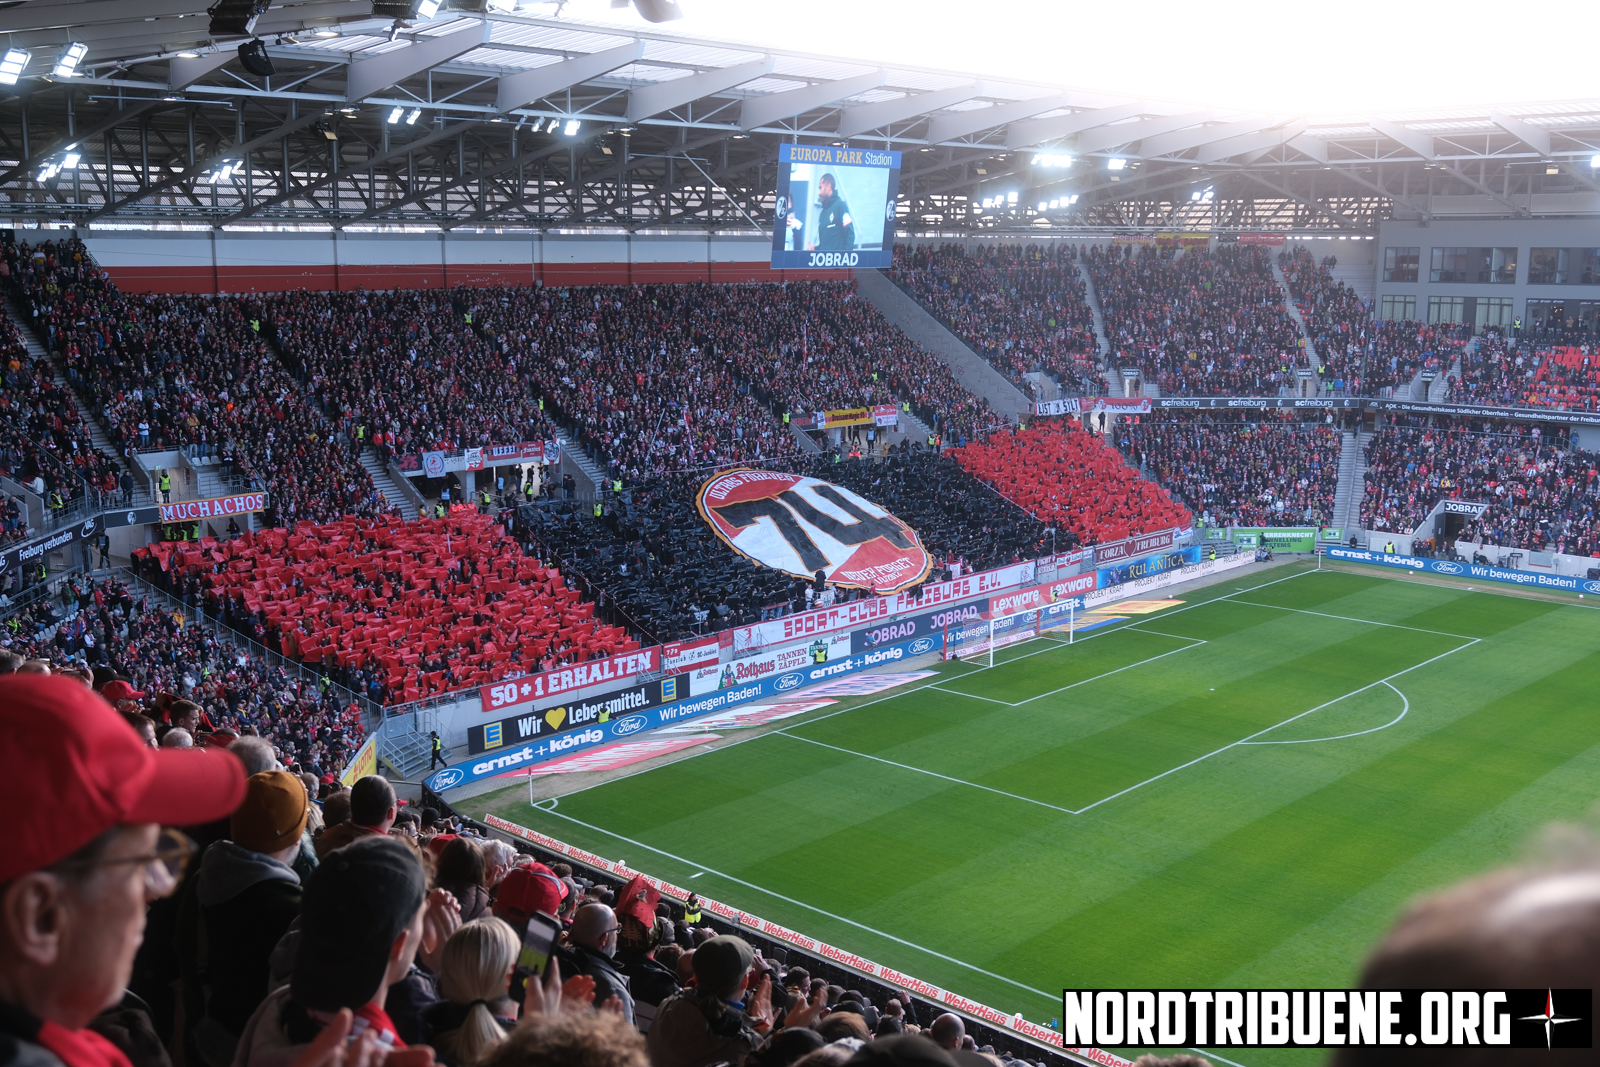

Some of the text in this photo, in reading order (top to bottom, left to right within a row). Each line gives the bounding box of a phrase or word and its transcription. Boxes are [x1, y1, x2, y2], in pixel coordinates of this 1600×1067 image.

[790, 147, 892, 165] EUROPA PARK Stadion
[808, 252, 859, 266] JOBRAD
[1161, 399, 1199, 407] scfreiburg
[1228, 399, 1266, 407] scfreiburg
[1295, 399, 1333, 407] scfreiburg
[1411, 405, 1456, 413] Gesundheitskasse
[1457, 407, 1481, 415] Südlicher
[1514, 411, 1569, 421] Gesundheitspartner
[708, 471, 796, 500] ULTRAS FOREVER
[161, 494, 264, 522] MUCHACHOS
[709, 484, 918, 574] 74
[19, 530, 73, 561] Freiburg verbunden
[1099, 545, 1124, 561] FORZA
[1136, 534, 1171, 552] FREIBURG
[1330, 549, 1371, 561] ernst
[1383, 554, 1424, 569] könig
[1437, 562, 1458, 573] Ford
[1134, 575, 1155, 588] PROJEKT
[1471, 566, 1488, 577] Wir
[1489, 567, 1538, 583] bewegen
[1539, 573, 1576, 588] Baden!
[993, 590, 1039, 612] Lexware
[1085, 588, 1106, 601] PROJEKT
[784, 598, 888, 638] SPORT-CLUB
[930, 605, 977, 629] JOBRAD
[942, 632, 956, 643] Wir
[956, 624, 989, 641] bewegen
[777, 647, 807, 662] TANNEN
[913, 639, 930, 653] Ford
[547, 650, 652, 693] ERHALTEN
[736, 659, 775, 680] Rothaus
[778, 656, 807, 671] ZÄPFLE
[810, 659, 853, 679] ernst
[864, 647, 903, 666] könig
[779, 676, 798, 689] Ford
[659, 706, 678, 721] Wir
[679, 693, 726, 712] bewegen
[727, 684, 762, 703] Baden!
[518, 716, 542, 738] Wir
[619, 717, 641, 733] Ford
[358, 746, 373, 775] LOTTO
[472, 746, 533, 775] ernst
[549, 729, 603, 754] könig
[435, 772, 456, 790] Ford
[486, 814, 524, 836] WeberHaus
[526, 830, 565, 852] WeberHaus
[567, 846, 609, 870] WeberHaus
[763, 922, 815, 950] WeberHaus
[819, 943, 875, 973] WeberHaus
[880, 966, 939, 998] WeberHaus
[944, 991, 1007, 1026] WeberHaus
